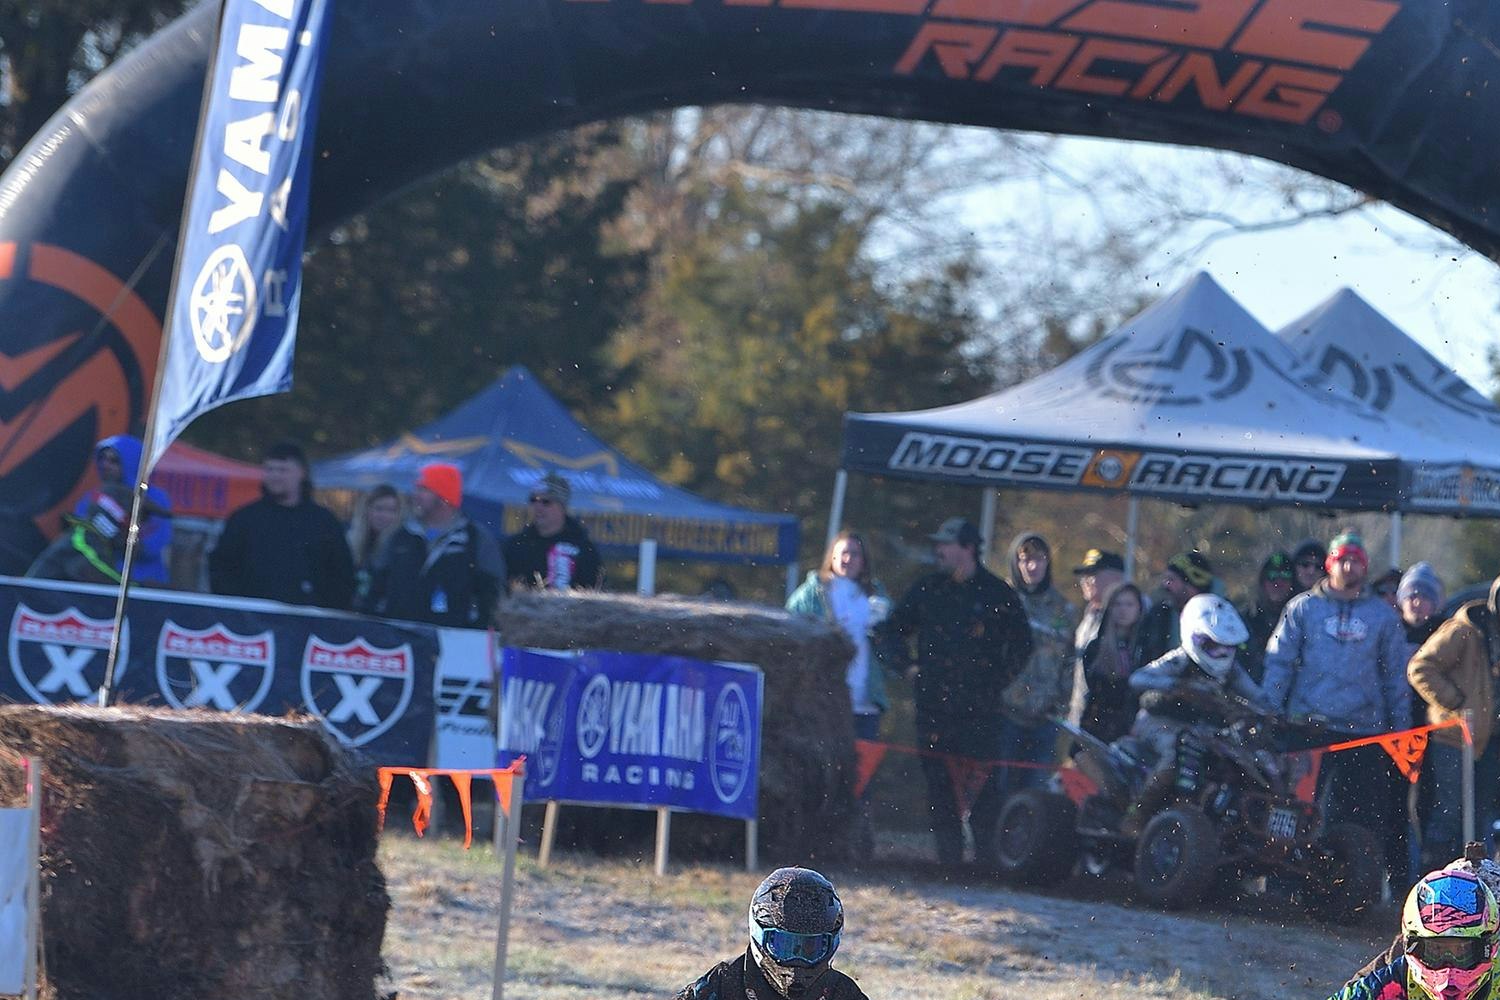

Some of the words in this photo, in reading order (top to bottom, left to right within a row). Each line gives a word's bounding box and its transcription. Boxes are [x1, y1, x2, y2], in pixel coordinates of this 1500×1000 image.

[894, 23, 1345, 125] RACING
[896, 434, 1092, 485] MOOSE
[1134, 454, 1343, 500] RACING
[36, 644, 98, 697] X
[184, 659, 242, 712] X
[313, 650, 404, 672] RACER
[326, 672, 384, 726] X
[581, 762, 696, 791] RACING
